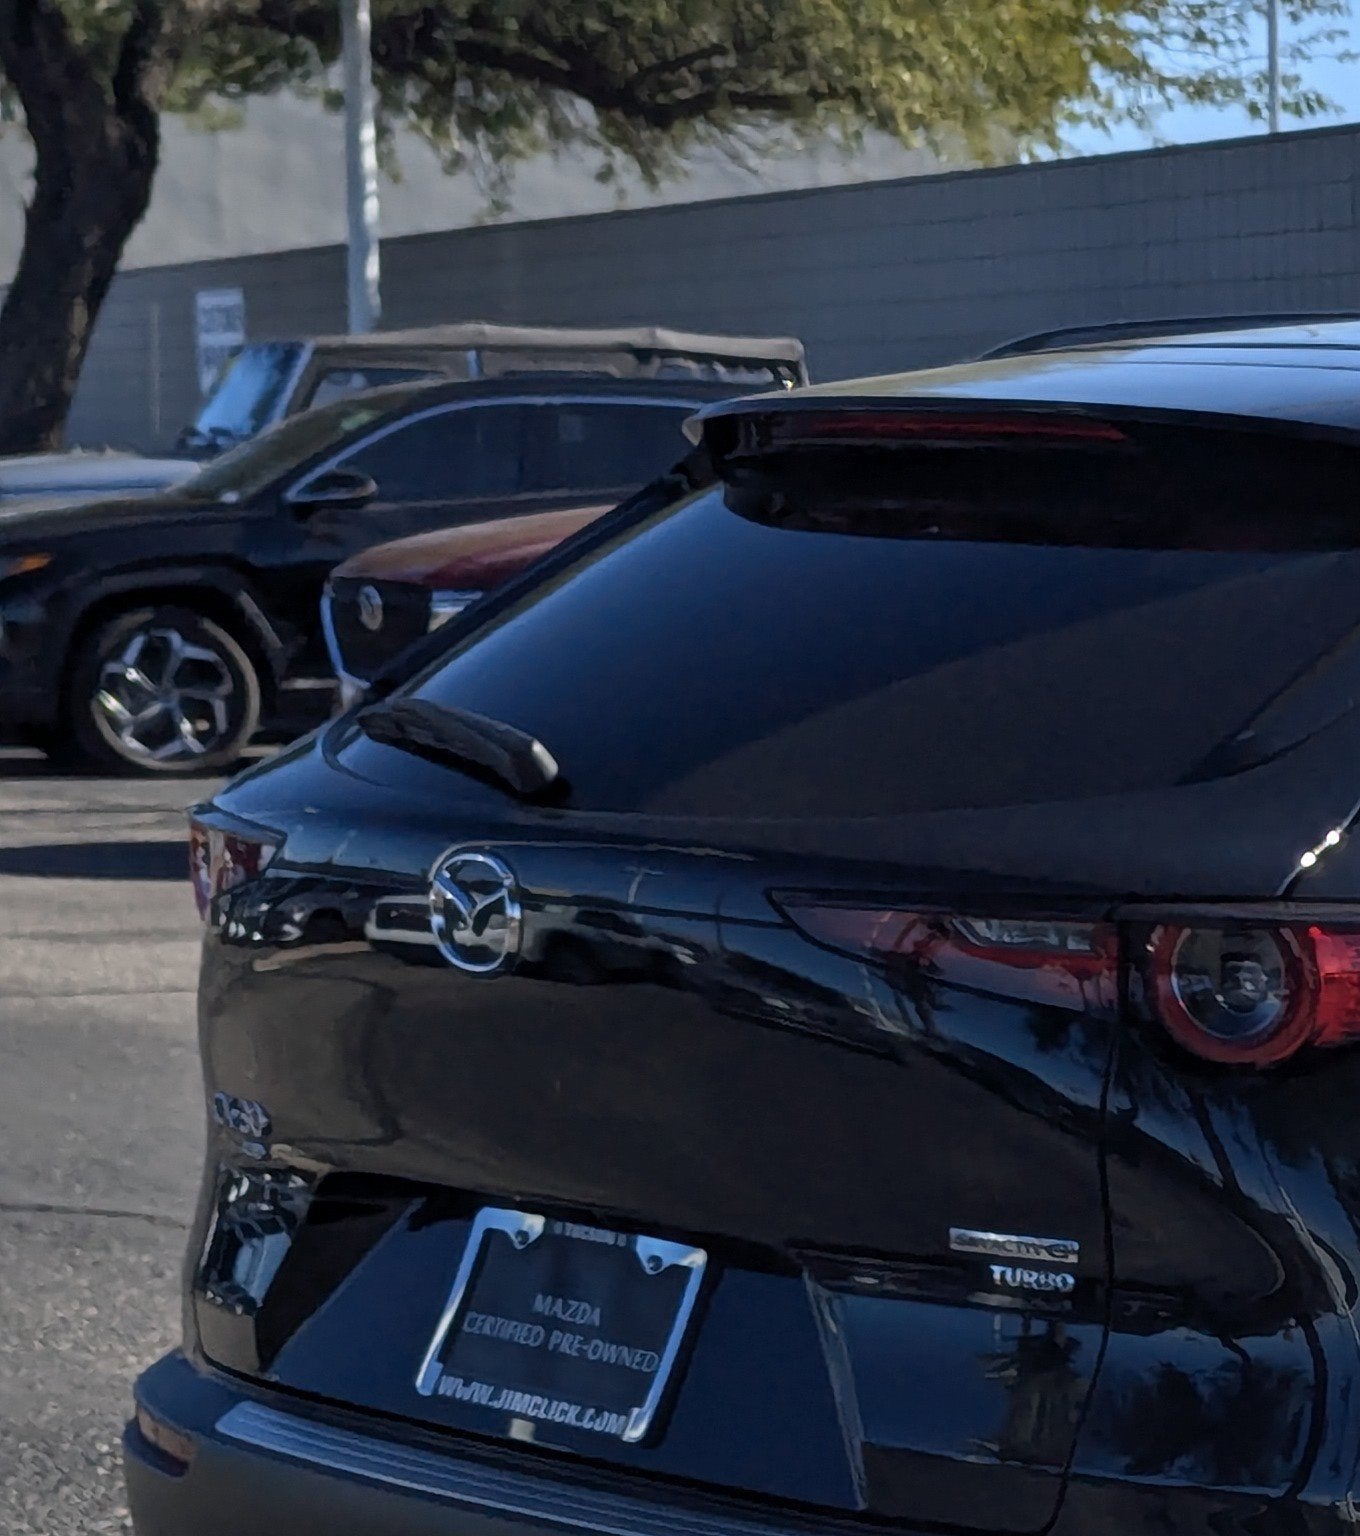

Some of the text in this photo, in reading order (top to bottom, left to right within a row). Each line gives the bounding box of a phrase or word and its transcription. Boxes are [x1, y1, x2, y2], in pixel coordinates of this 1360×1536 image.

[989, 1264, 1075, 1292] TURBO
[532, 1294, 600, 1327] MAZDA
[462, 1311, 660, 1373] CERTIFIED PRE-OWNED
[438, 1375, 628, 1434] WWW.JIMCLICK.COM
